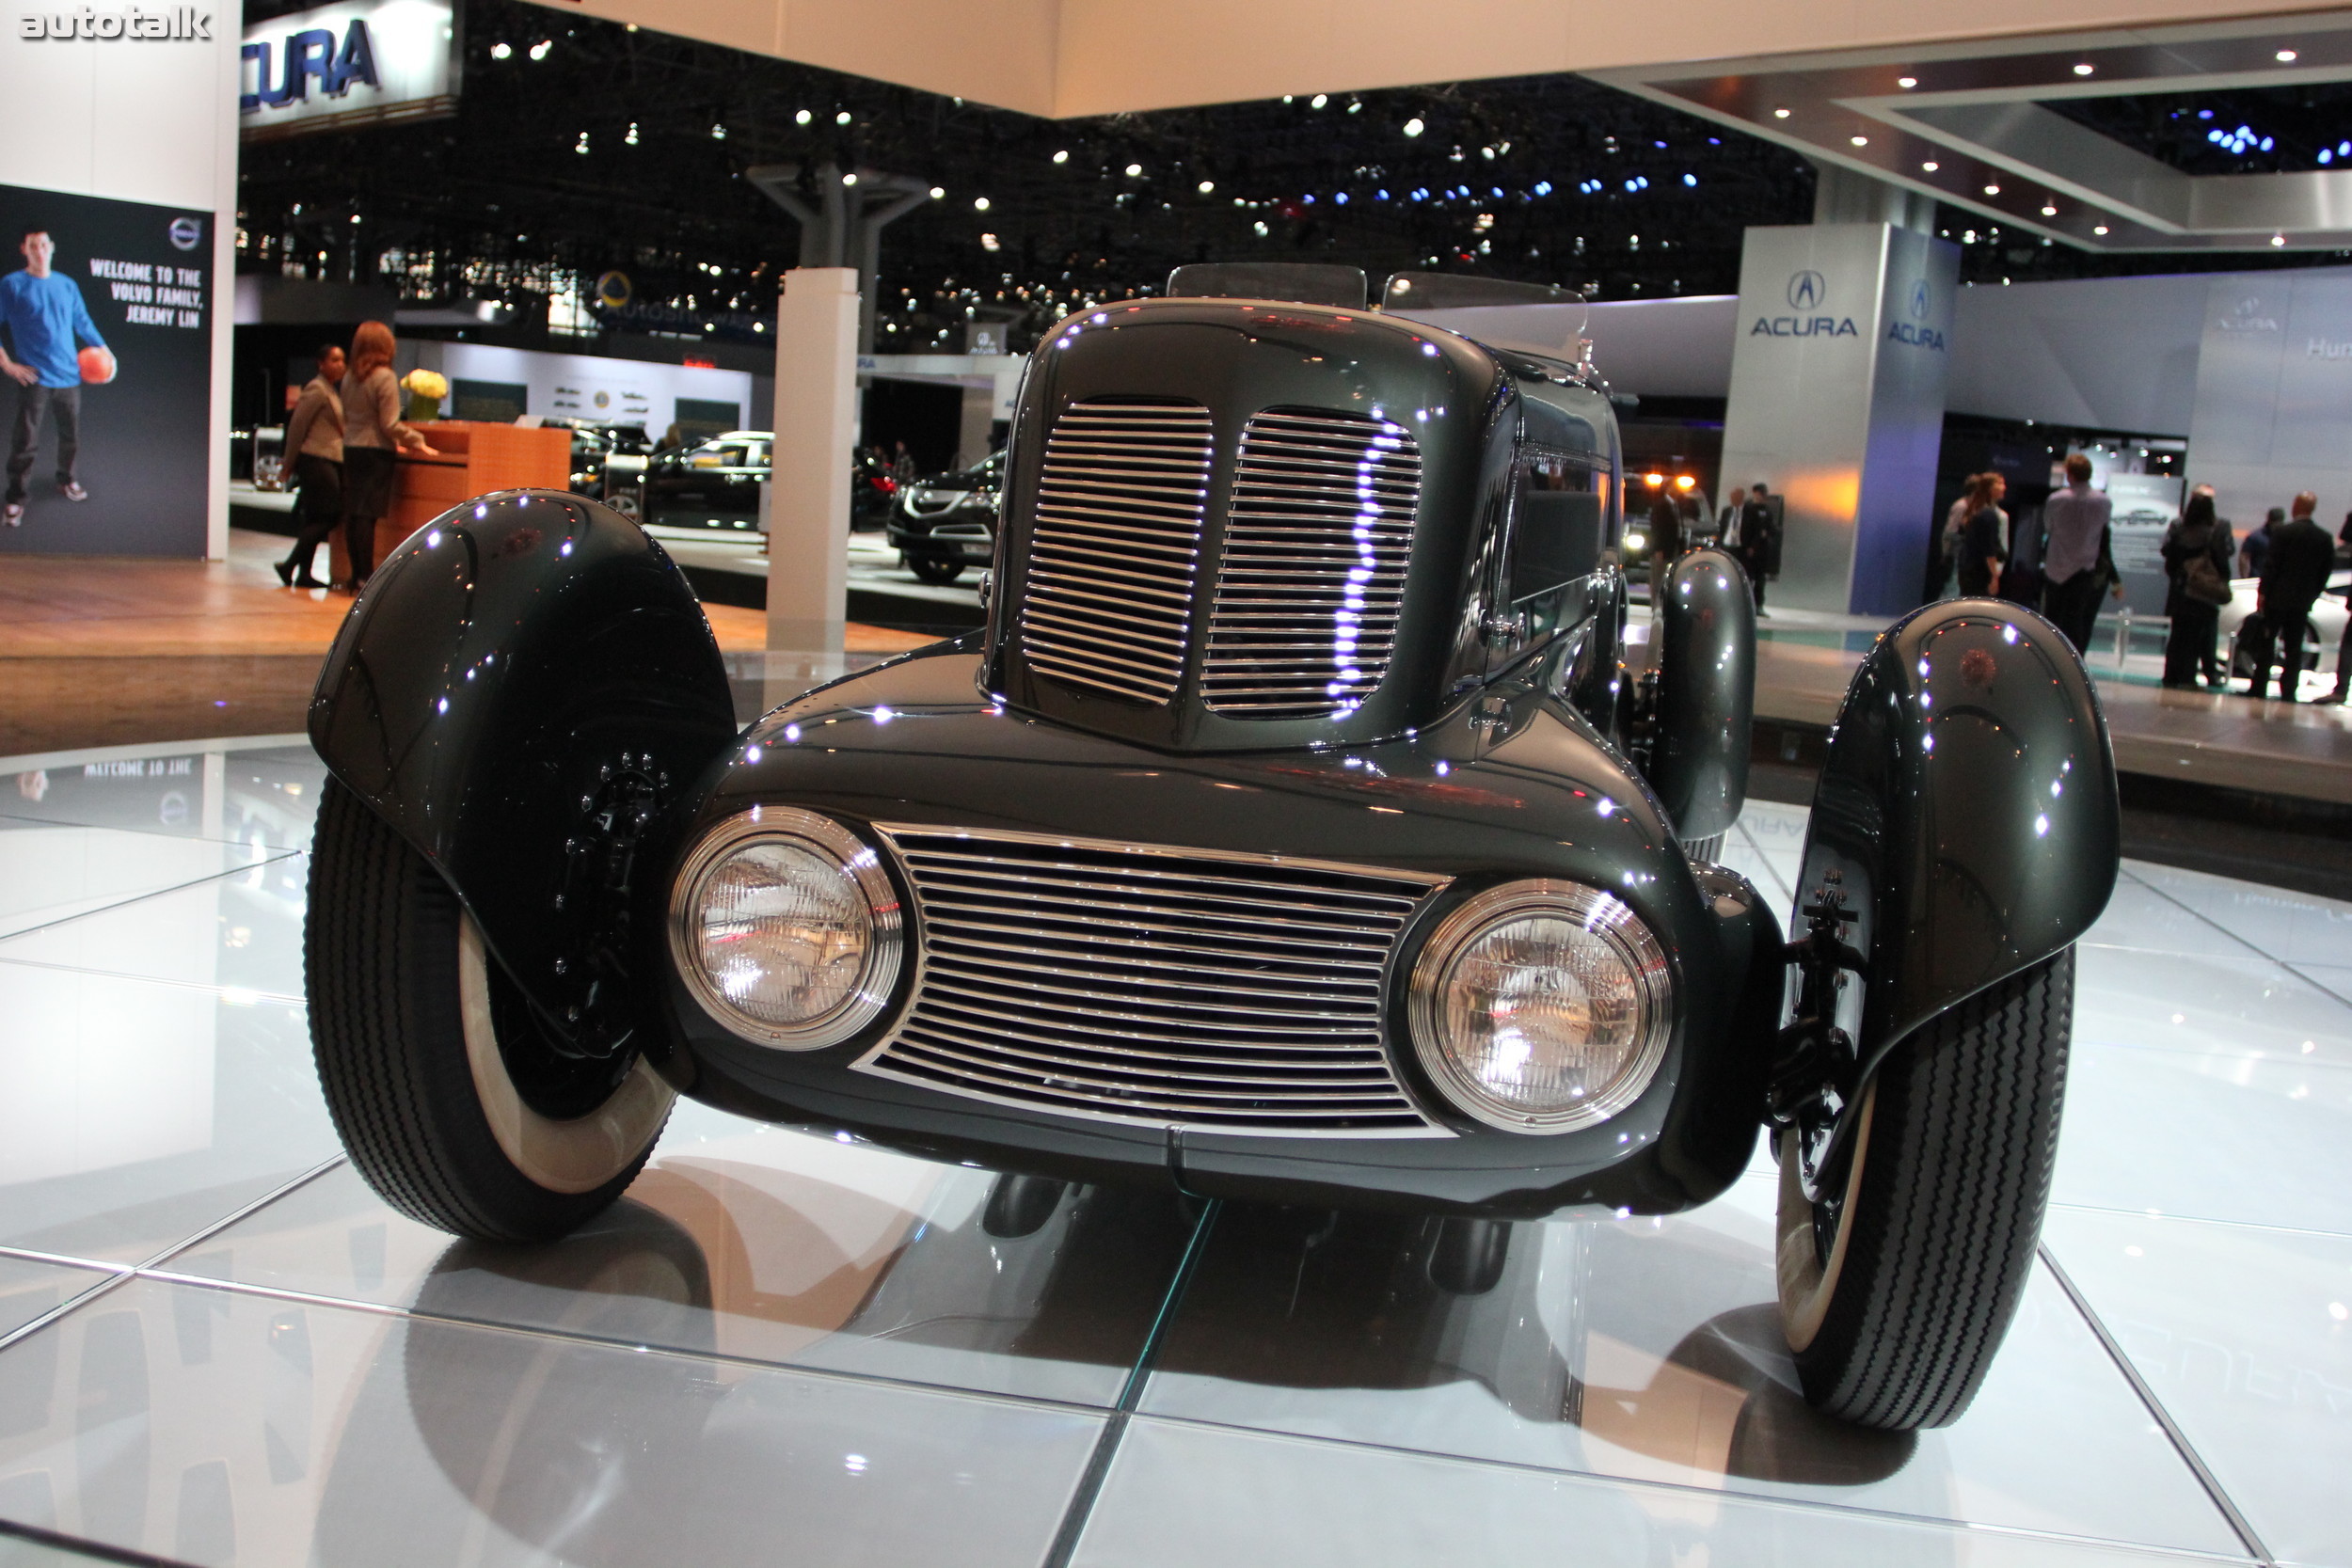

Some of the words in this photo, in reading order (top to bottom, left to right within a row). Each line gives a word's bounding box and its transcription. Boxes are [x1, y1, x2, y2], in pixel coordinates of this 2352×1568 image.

[241, 19, 381, 111] CURA
[89, 258, 152, 282] WELCOME
[155, 265, 173, 285] TO
[177, 267, 201, 288] THE
[111, 281, 152, 303] VOLVO
[156, 286, 203, 309] FAMILY,
[125, 304, 174, 326] JEREMY
[178, 309, 199, 329] LIN
[1750, 316, 1858, 337] ACURA
[1887, 321, 1945, 352] ACURA
